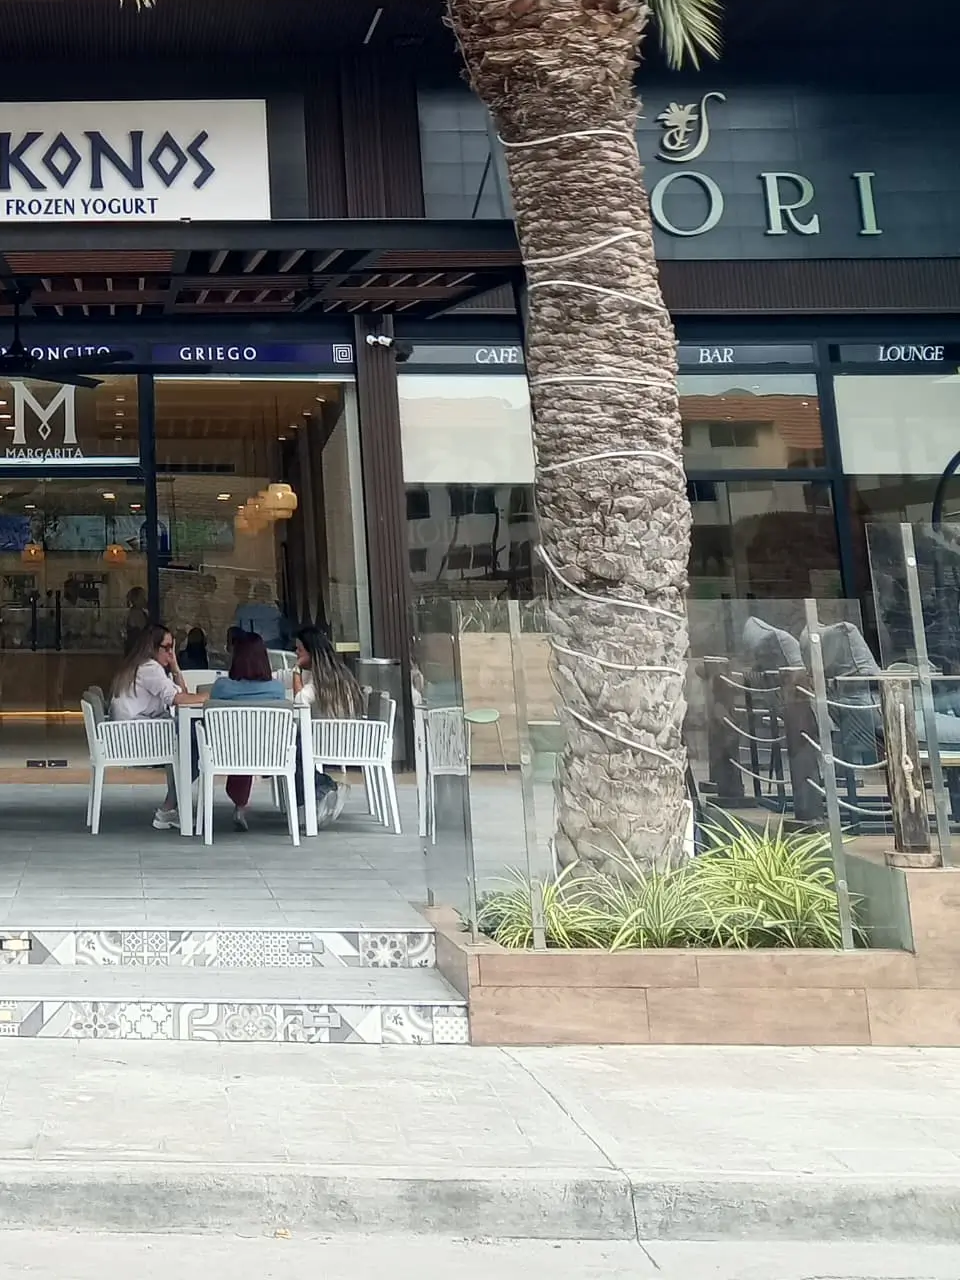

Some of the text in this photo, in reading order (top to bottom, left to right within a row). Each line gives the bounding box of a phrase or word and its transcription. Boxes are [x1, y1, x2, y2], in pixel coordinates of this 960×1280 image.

[6, 198, 75, 215] FROZEN
[81, 197, 159, 214] YOGURT
[650, 170, 883, 236] ORI
[179, 346, 257, 361] GRIEGO
[699, 346, 735, 364] BAR
[878, 345, 945, 362] LOUNGE
[9, 380, 78, 444] M
[5, 447, 84, 460] MARGARITA
